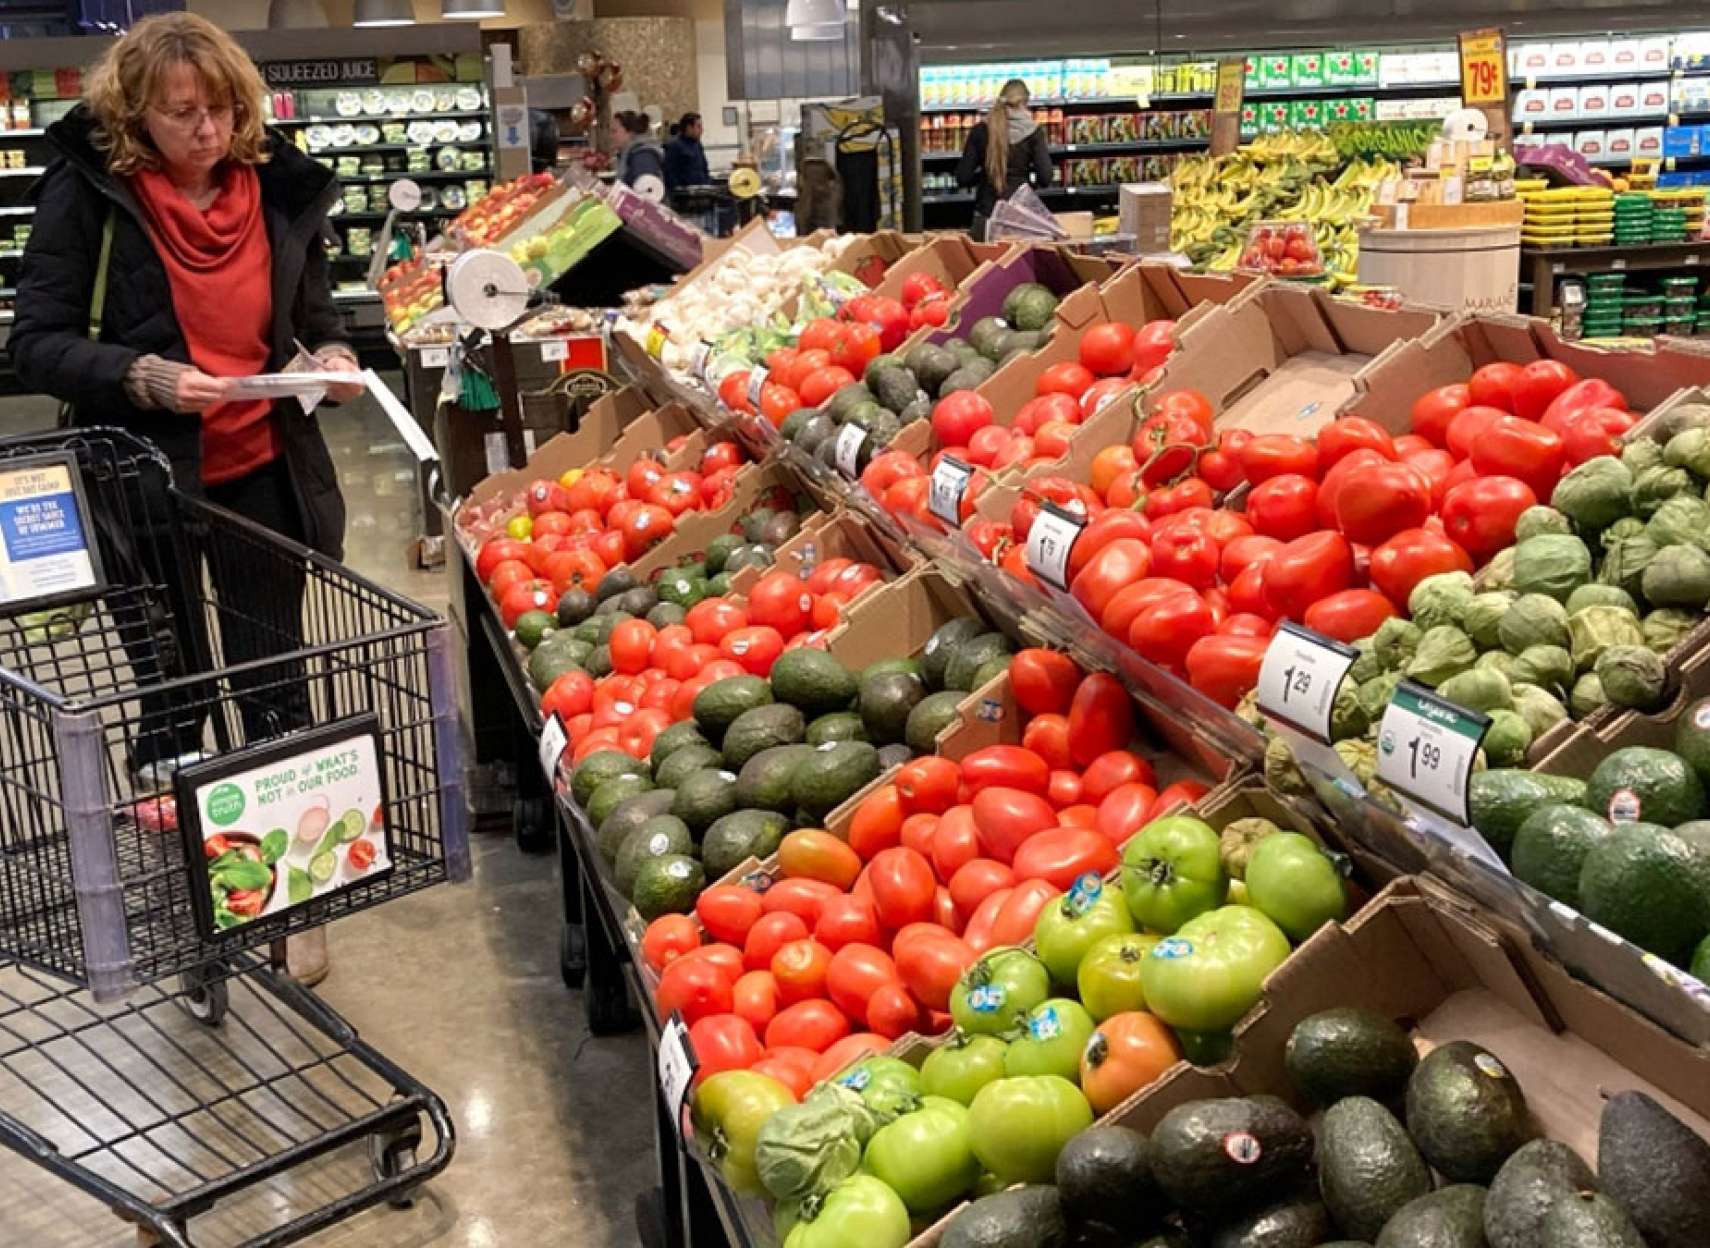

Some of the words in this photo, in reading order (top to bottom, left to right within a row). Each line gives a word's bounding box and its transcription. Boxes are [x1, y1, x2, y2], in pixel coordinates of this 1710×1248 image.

[268, 62, 338, 81] SQUEEZED
[341, 60, 376, 79] JUICE
[255, 769, 296, 792] PROUD
[315, 749, 359, 771] WHAT'S
[257, 789, 282, 806] NOT
[298, 774, 324, 793] OUR
[326, 764, 358, 784] FOOD
